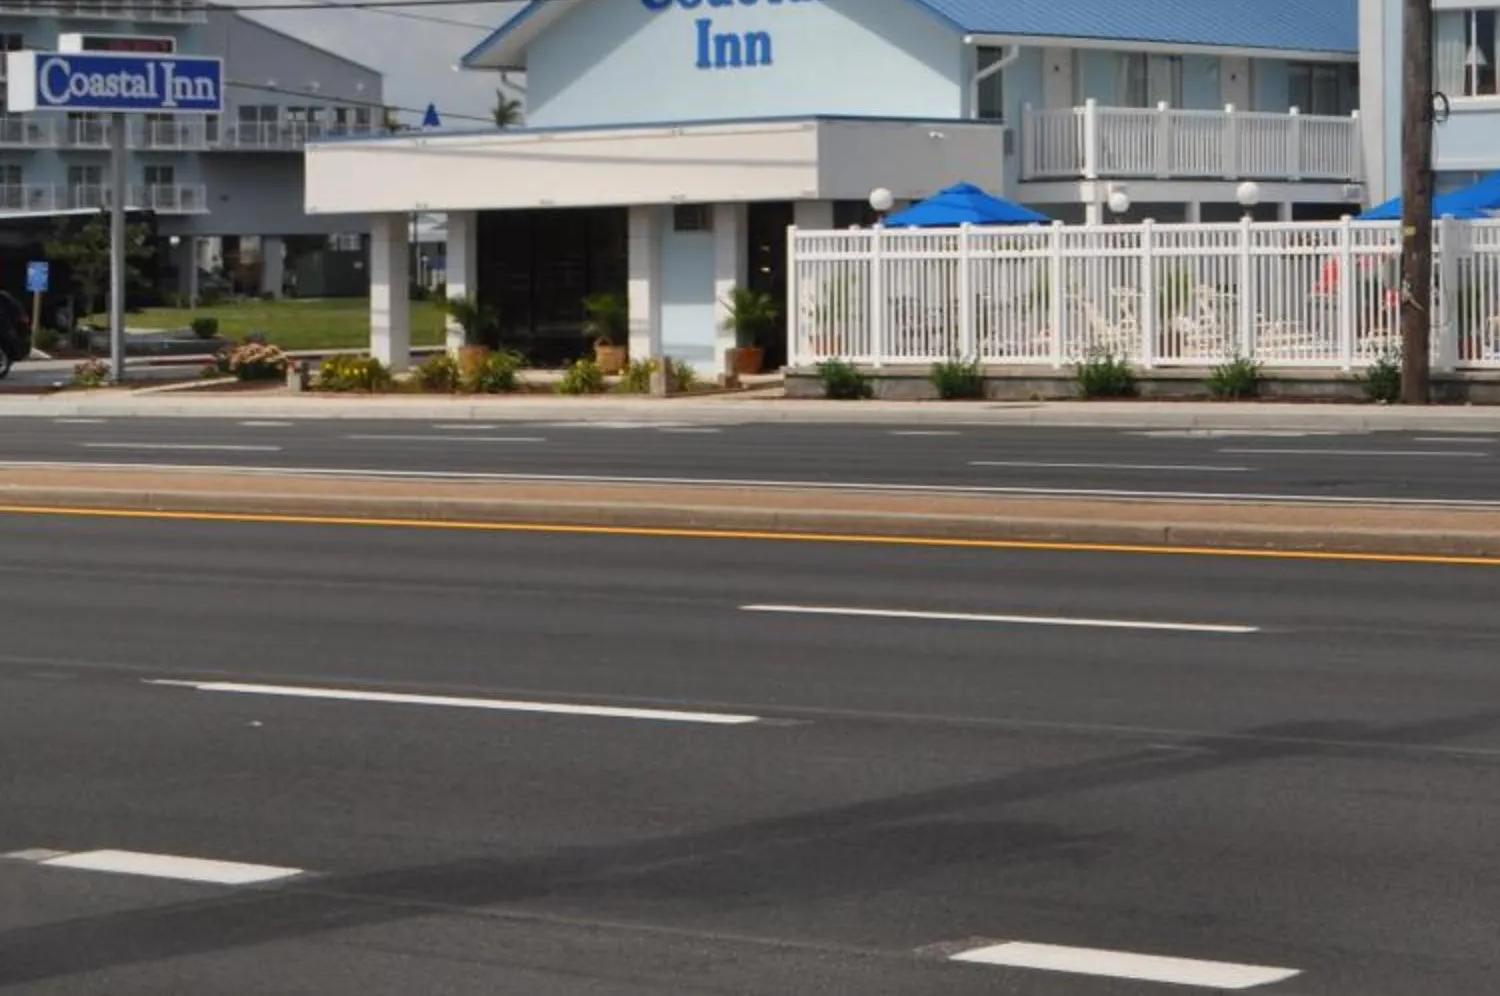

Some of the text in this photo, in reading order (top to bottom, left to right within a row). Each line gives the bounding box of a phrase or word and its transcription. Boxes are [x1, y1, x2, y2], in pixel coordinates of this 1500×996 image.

[695, 17, 773, 69] Inn
[40, 57, 216, 107] Coastal Inn
